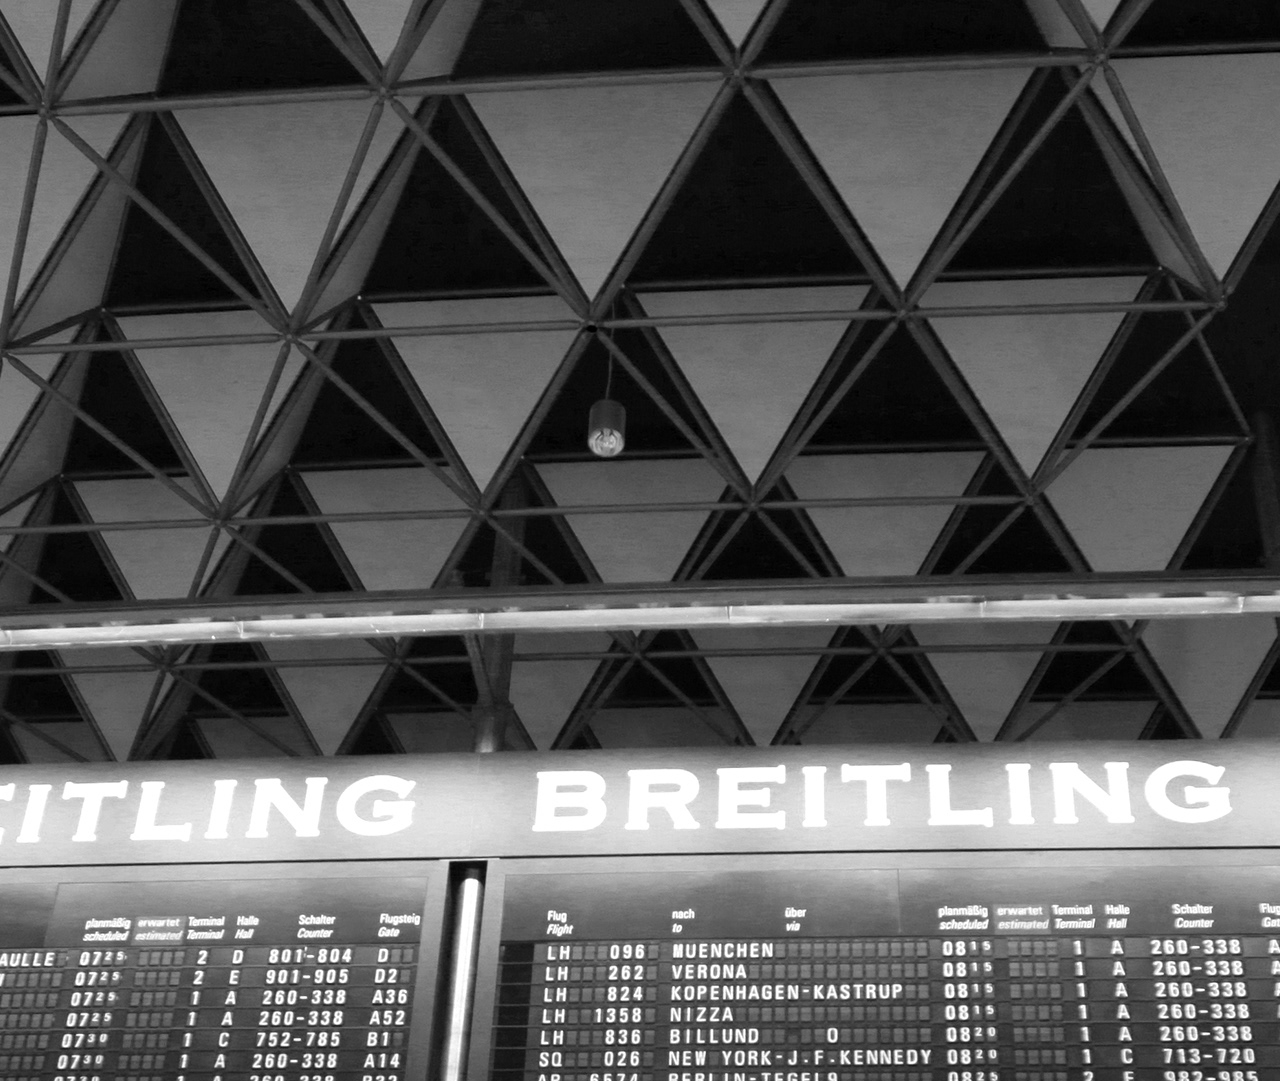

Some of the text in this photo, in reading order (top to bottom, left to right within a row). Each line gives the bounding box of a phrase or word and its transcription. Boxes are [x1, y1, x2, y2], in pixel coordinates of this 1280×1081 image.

[529, 759, 1234, 832] BREITLING
[269, 946, 351, 963] 801-804
[547, 939, 1241, 960] LH 096 MUENCHEN 260-338
[671, 984, 902, 1001] KOPENHAGEN-KASTRUP
[257, 1032, 340, 1047] 752-785
[669, 1051, 706, 1066] NEW
[1163, 1048, 1255, 1063] 713-720
